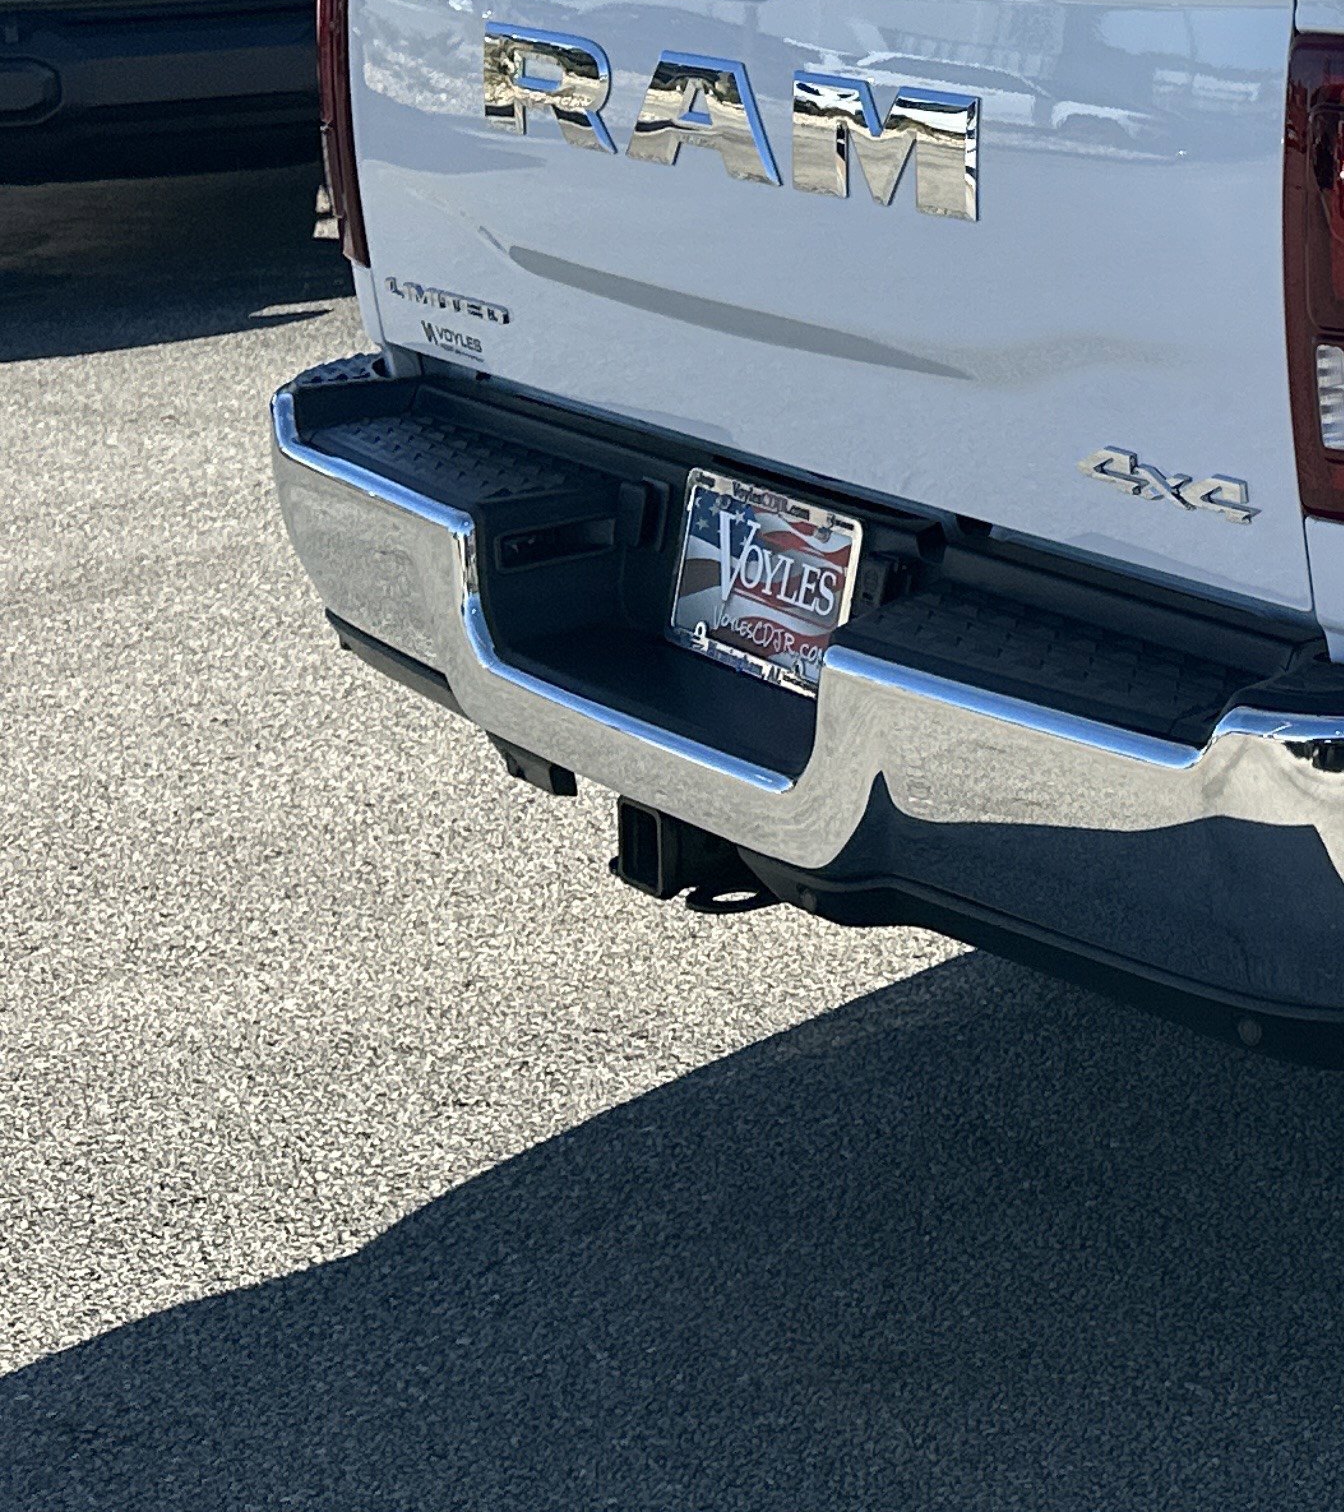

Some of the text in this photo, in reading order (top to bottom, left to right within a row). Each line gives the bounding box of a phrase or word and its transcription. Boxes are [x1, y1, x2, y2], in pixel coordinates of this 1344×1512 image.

[484, 21, 980, 222] RAM
[384, 276, 511, 326] LIMITED
[435, 325, 483, 353] VOYLES
